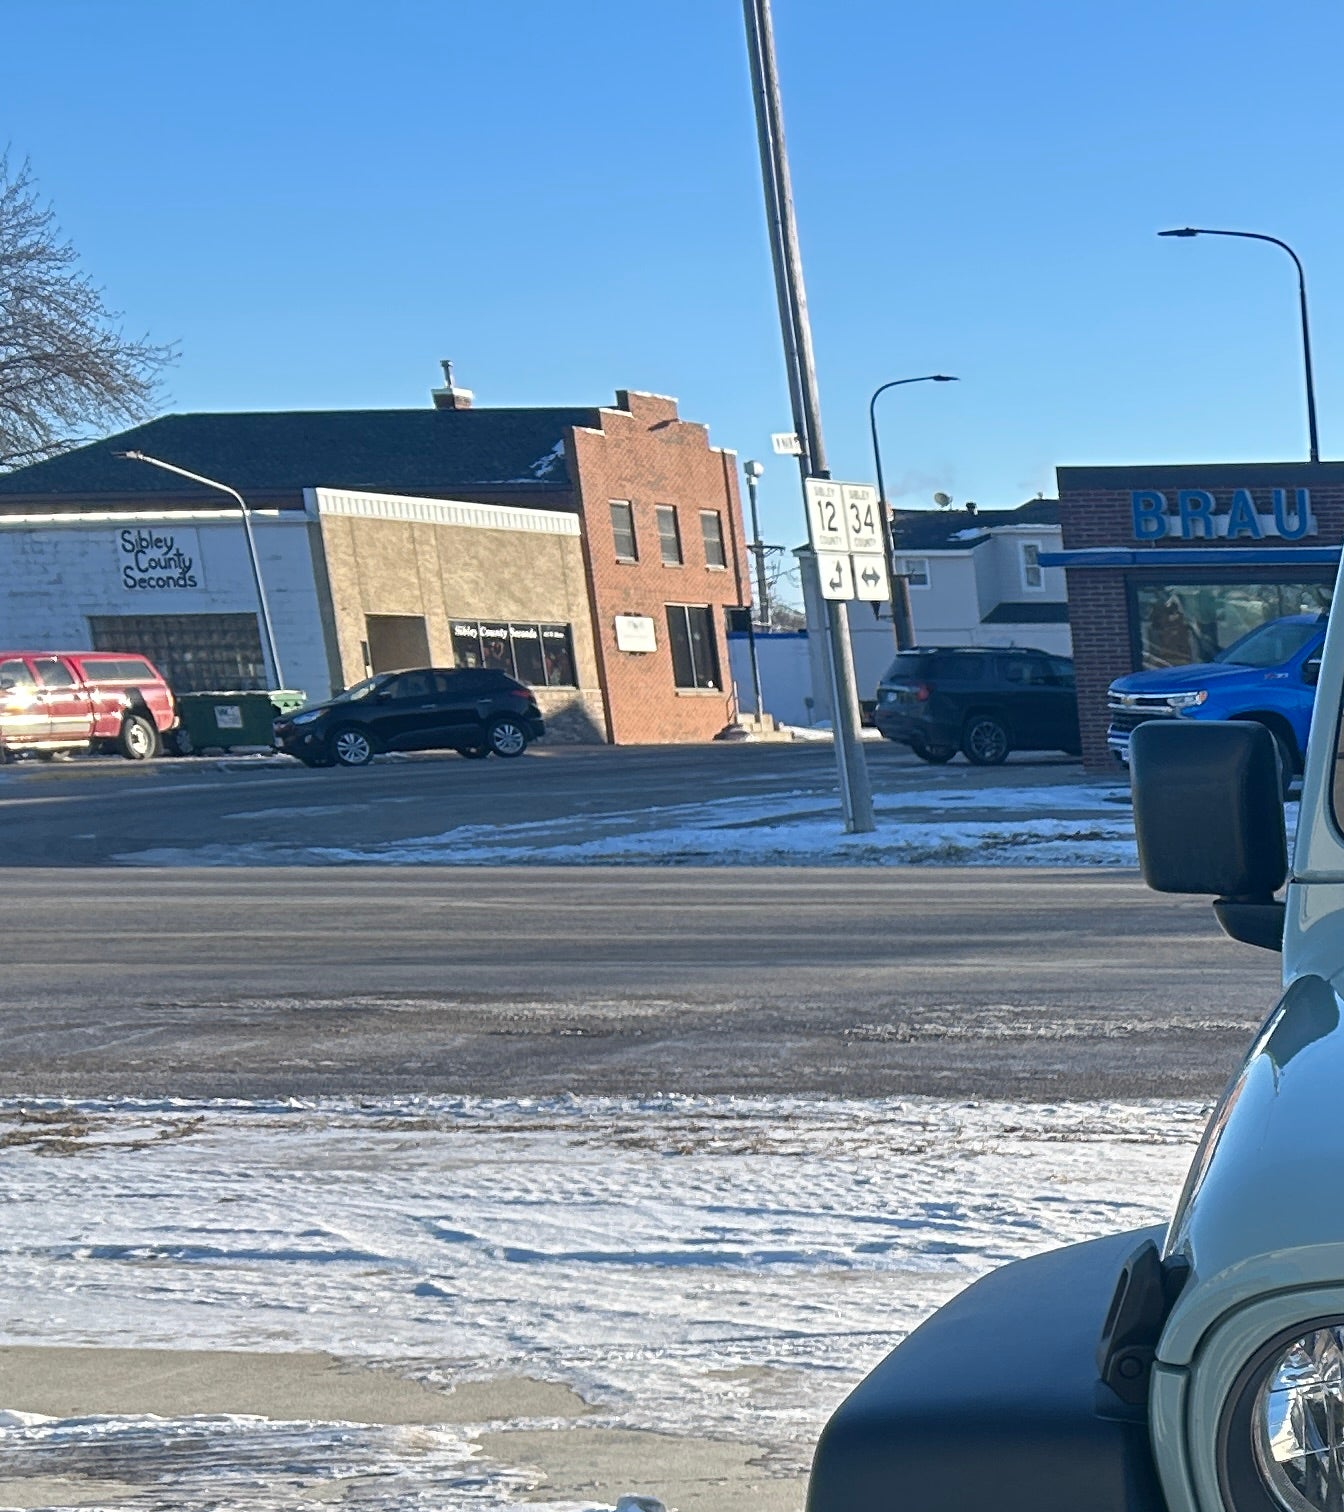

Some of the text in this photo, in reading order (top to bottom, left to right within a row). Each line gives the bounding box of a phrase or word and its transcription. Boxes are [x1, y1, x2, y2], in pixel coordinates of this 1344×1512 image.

[818, 500, 838, 532] 12
[850, 503, 875, 535] 34
[1131, 487, 1310, 540] BRAU
[121, 529, 174, 556] Sibley
[134, 548, 192, 575] County
[123, 565, 197, 588] Seconds
